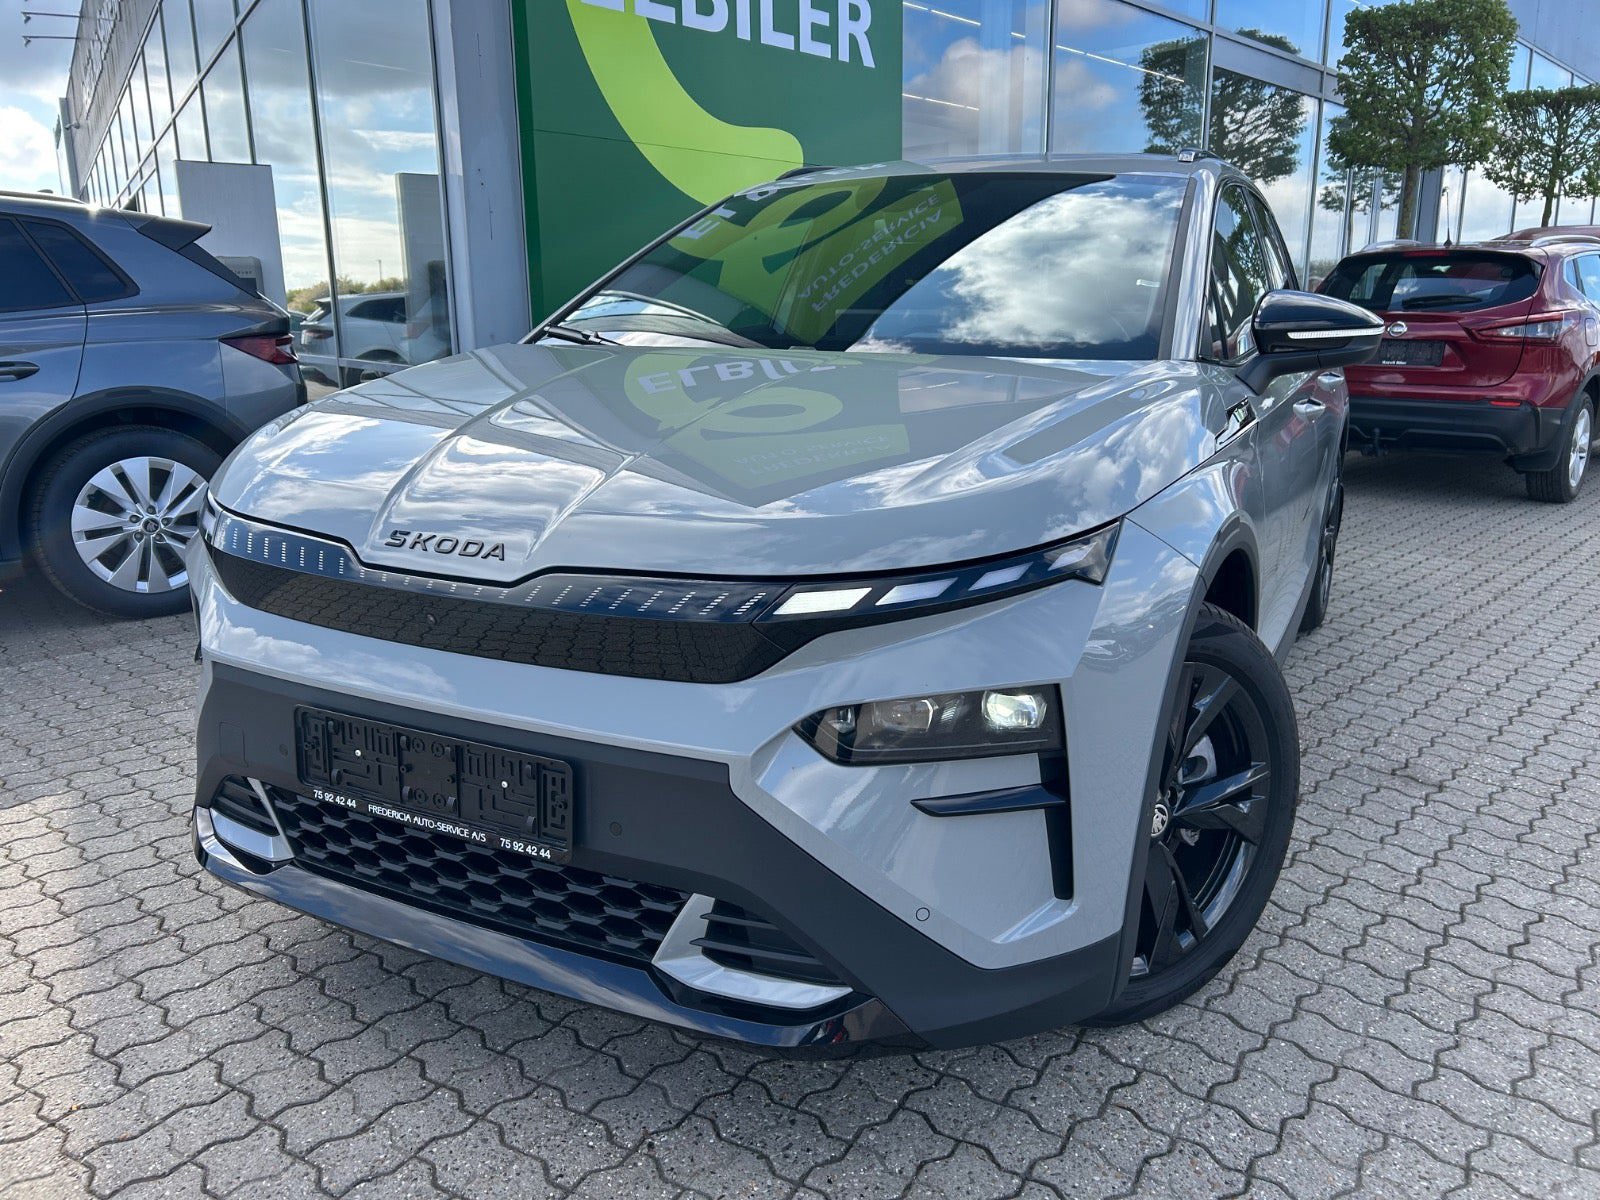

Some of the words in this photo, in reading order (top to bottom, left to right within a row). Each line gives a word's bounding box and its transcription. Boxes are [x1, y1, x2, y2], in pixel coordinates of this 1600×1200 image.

[580, 0, 875, 68] BILER
[313, 789, 324, 799] 75
[324, 792, 334, 802] 92
[335, 795, 345, 805] 42
[346, 798, 357, 808] 44
[368, 804, 411, 823] FREDERICIA
[413, 816, 470, 838] AUTO-SERVICE
[471, 831, 487, 843] A/S
[500, 837, 511, 848] 75
[513, 841, 524, 852] 92
[526, 844, 537, 855] 42
[539, 848, 551, 859] 44
